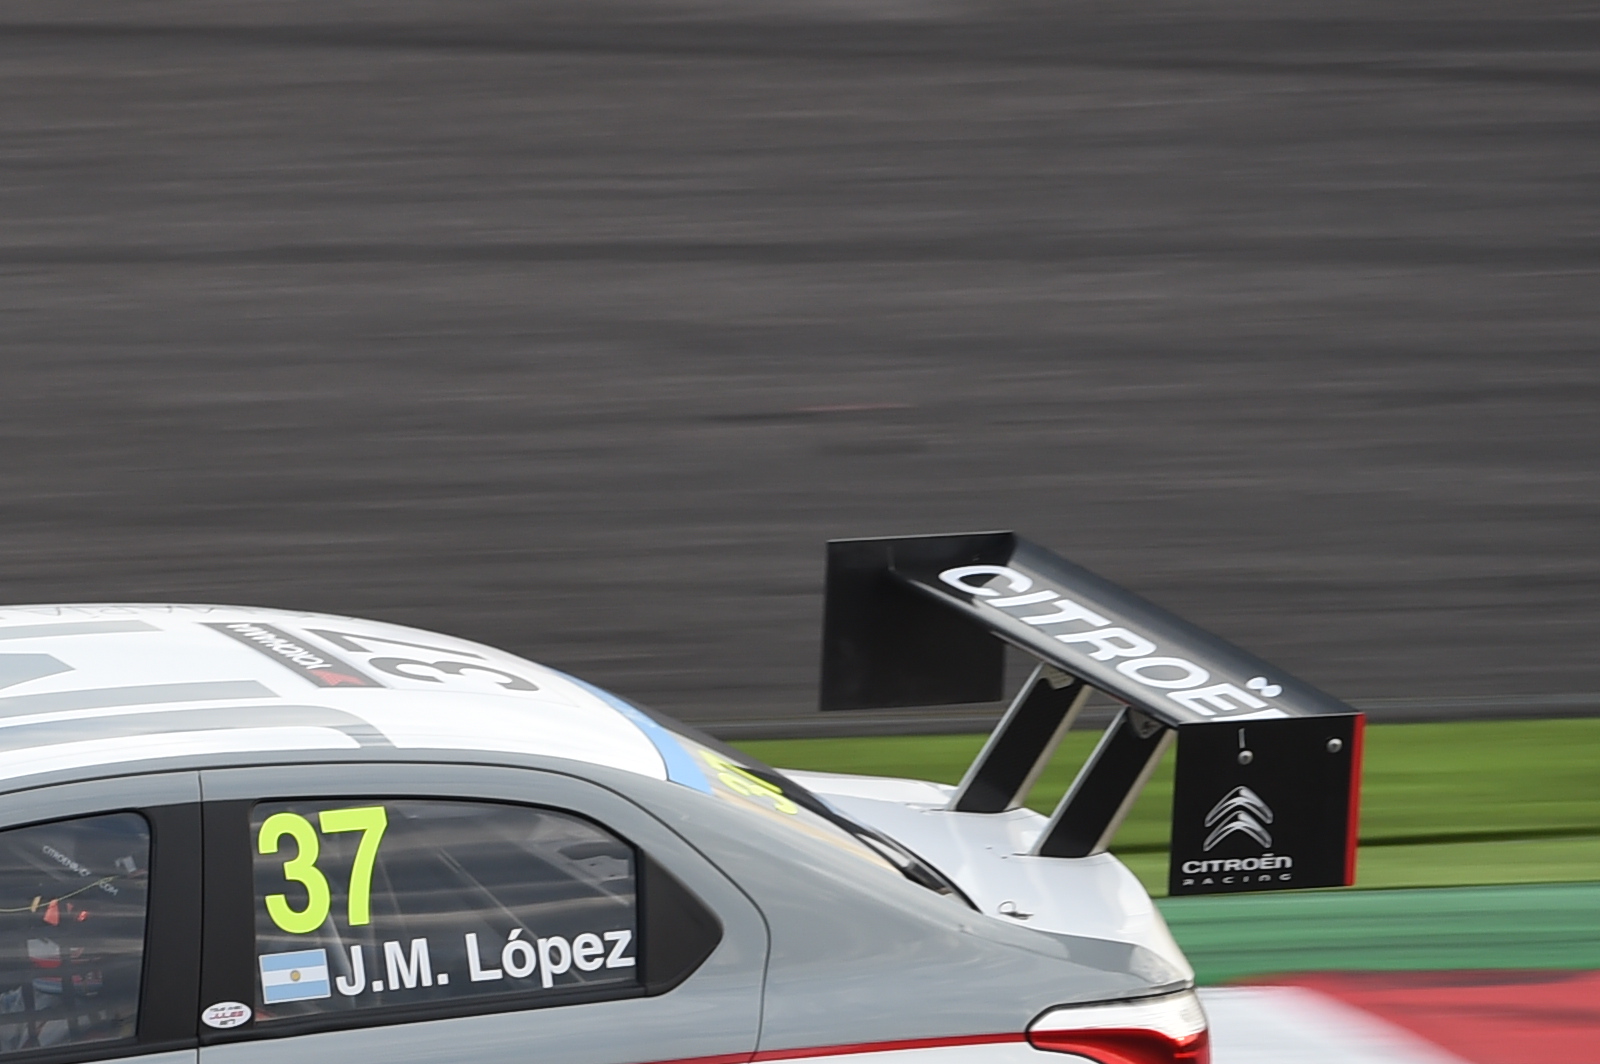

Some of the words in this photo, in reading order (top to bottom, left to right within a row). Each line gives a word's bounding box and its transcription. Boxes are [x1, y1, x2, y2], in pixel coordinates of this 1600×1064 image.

[305, 628, 539, 692] 37
[258, 806, 387, 933] 37
[1181, 852, 1293, 874] CITROËN
[1181, 872, 1292, 886] RACING
[335, 944, 449, 996] J.M.
[465, 928, 636, 989] López
